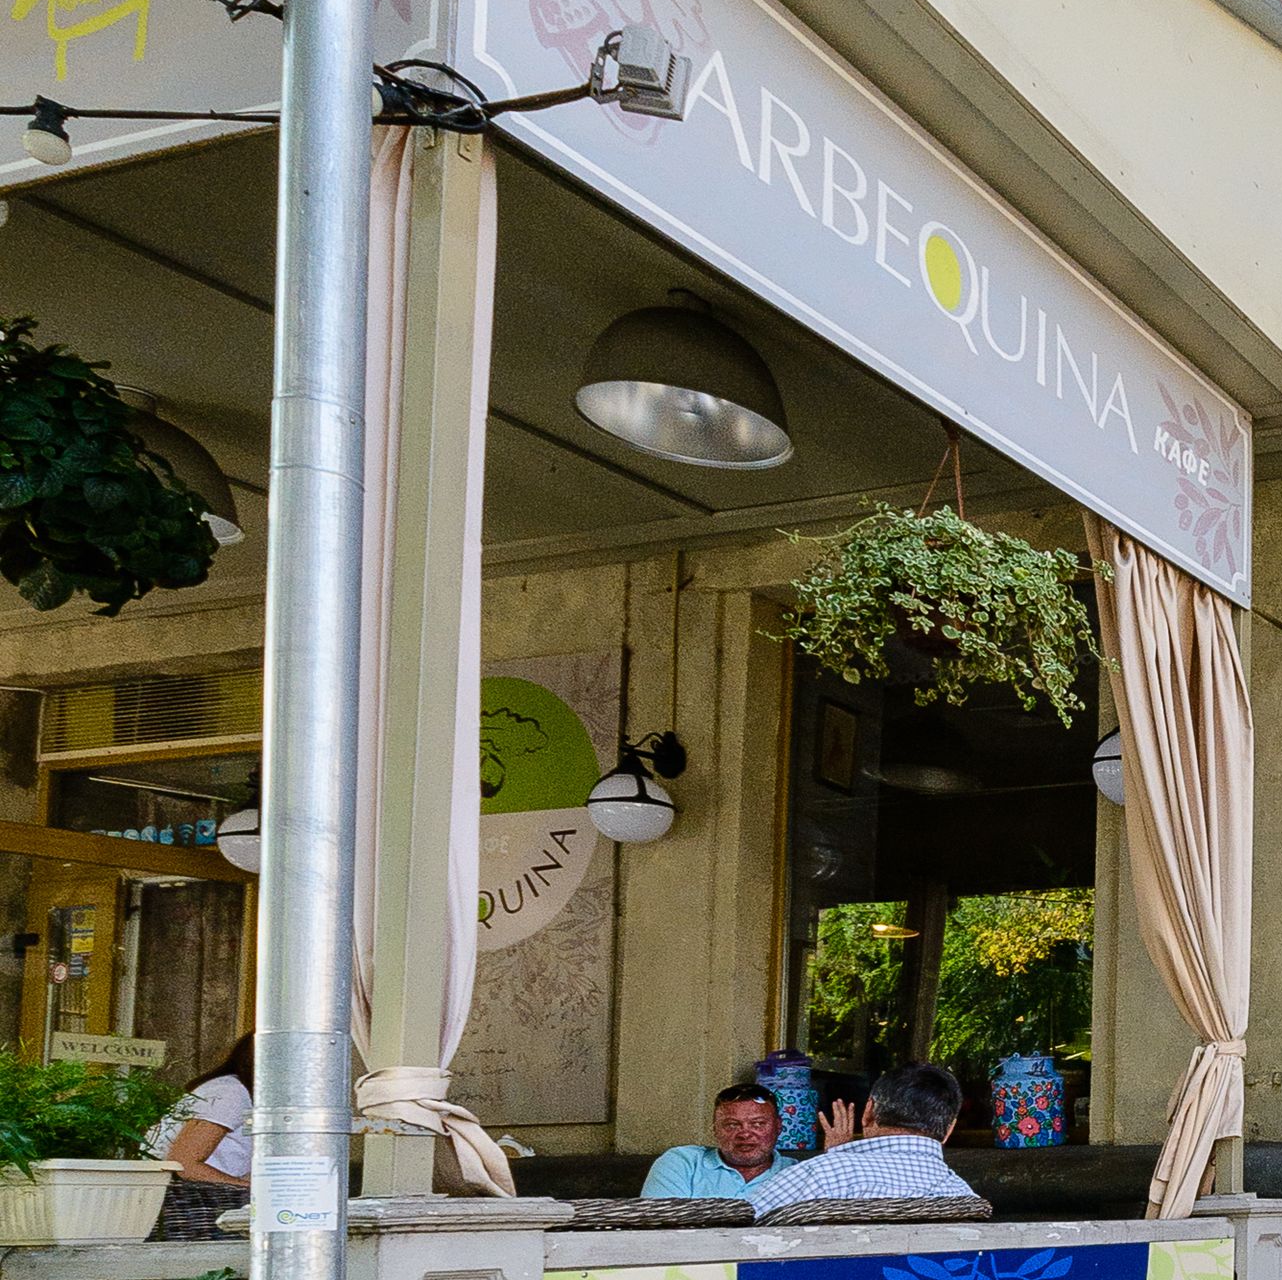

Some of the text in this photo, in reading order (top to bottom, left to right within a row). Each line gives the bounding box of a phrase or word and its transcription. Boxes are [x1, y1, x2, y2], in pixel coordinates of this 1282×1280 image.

[683, 50, 1138, 455] ARBEQUINA
[1154, 425, 1209, 486] КАФЕ
[478, 829, 577, 929] QUINA
[60, 1040, 157, 1058] WELCOME
